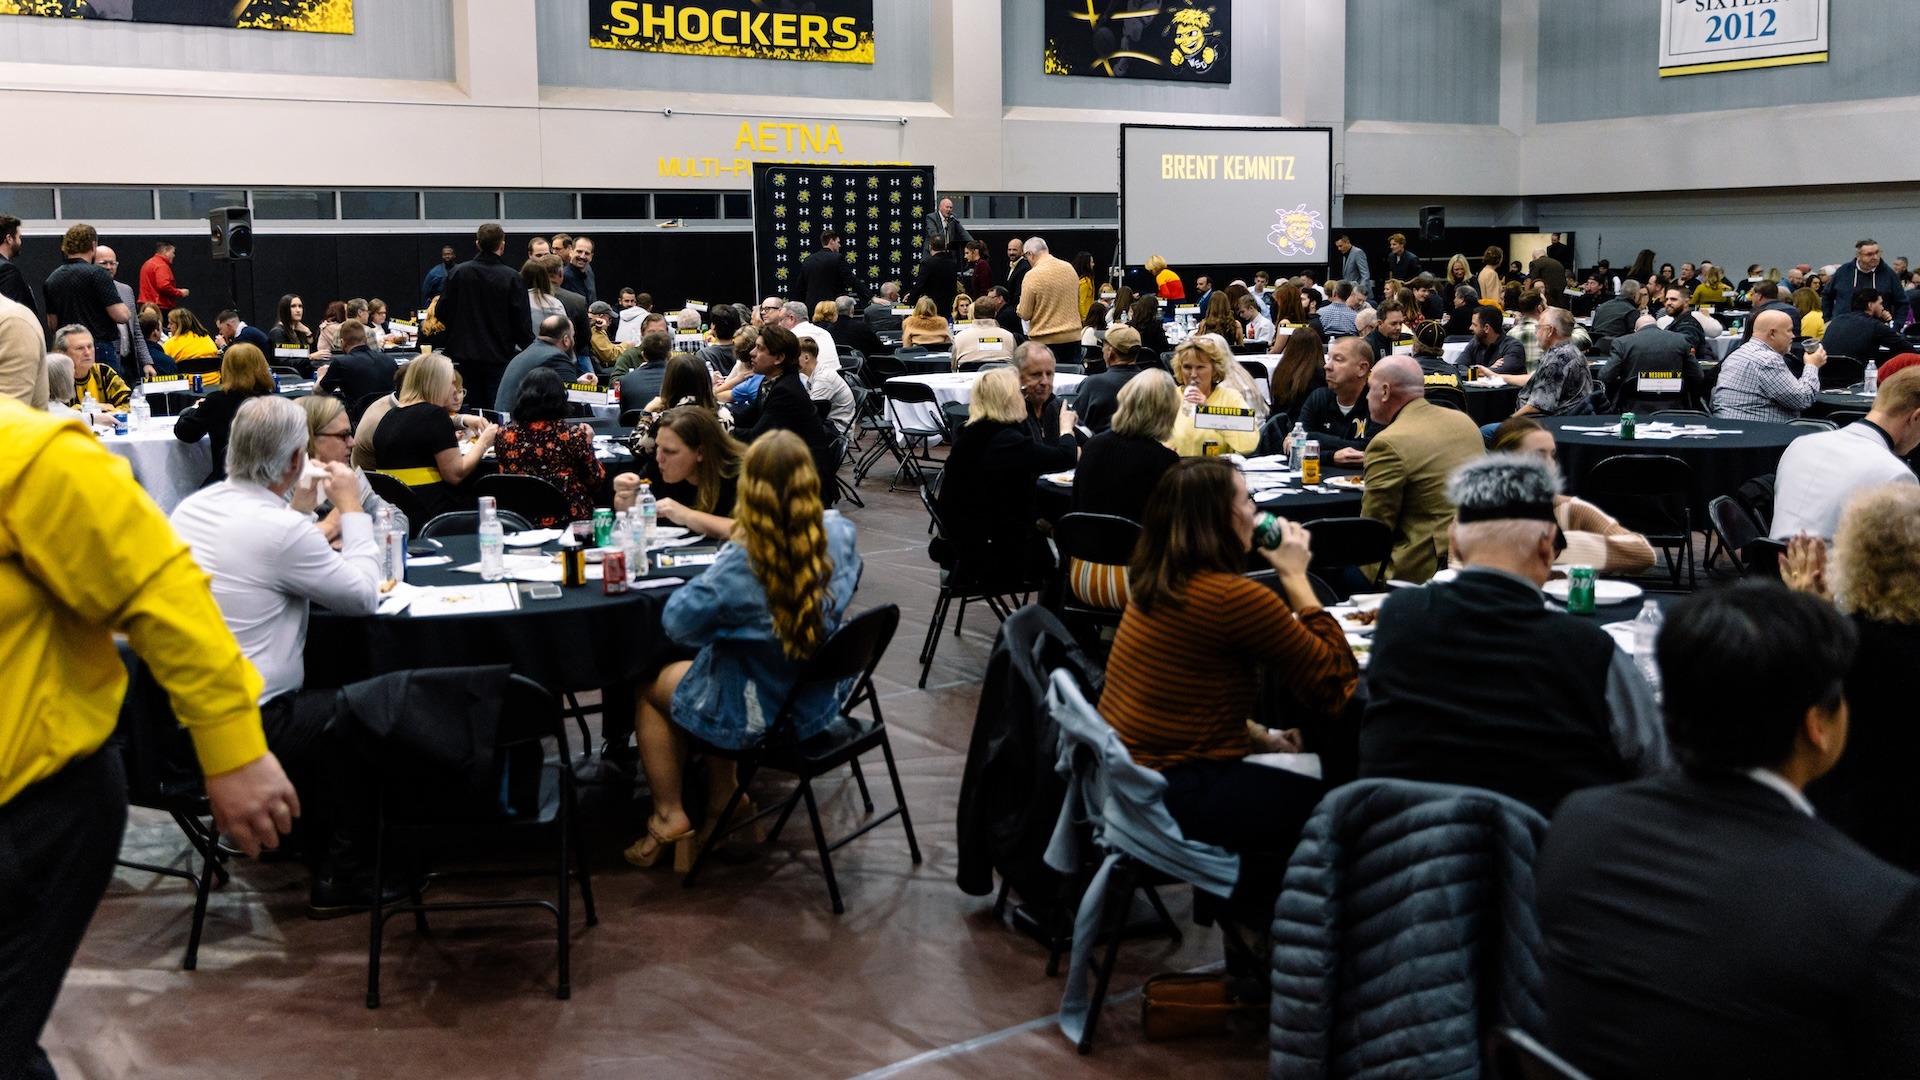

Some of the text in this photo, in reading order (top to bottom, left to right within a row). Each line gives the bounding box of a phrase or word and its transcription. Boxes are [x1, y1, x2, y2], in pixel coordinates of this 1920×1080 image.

[610, 0, 857, 49] SHOCKERS
[1705, 8, 1777, 43] 2012
[734, 121, 844, 153] AETNA
[1161, 154, 1296, 181] BRENT KEMNITZ
[571, 383, 598, 392] RESERVED
[1207, 406, 1242, 416] RESERVED
